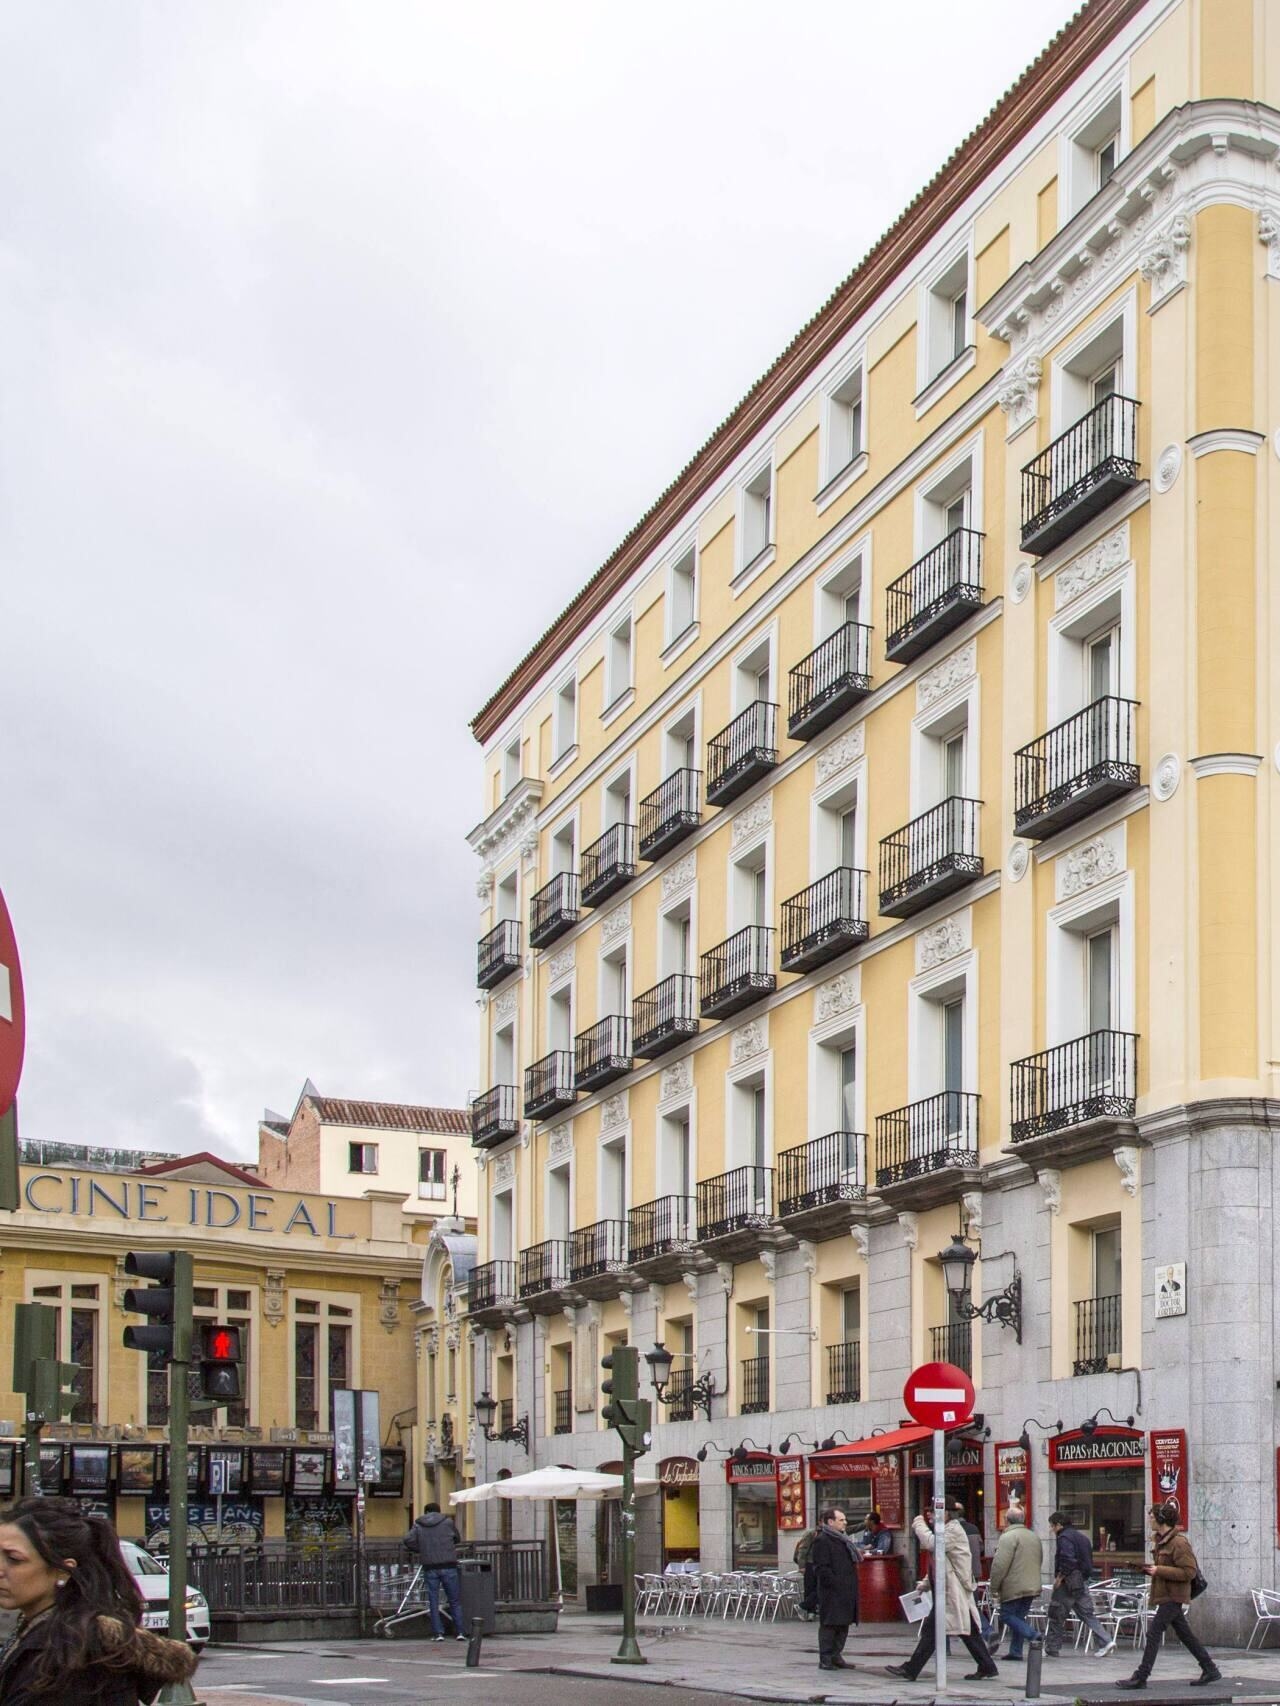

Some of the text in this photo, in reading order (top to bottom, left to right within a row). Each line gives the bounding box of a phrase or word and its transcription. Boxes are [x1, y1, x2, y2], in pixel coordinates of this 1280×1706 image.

[25, 1173, 356, 1239] CINE IDEAL
[43, 1421, 146, 1440] ELMO
[1057, 1444, 1086, 1460] TAPAS
[1093, 1440, 1144, 1458] RACIONES
[753, 1463, 775, 1475] VERMU
[916, 1453, 927, 1468] EL
